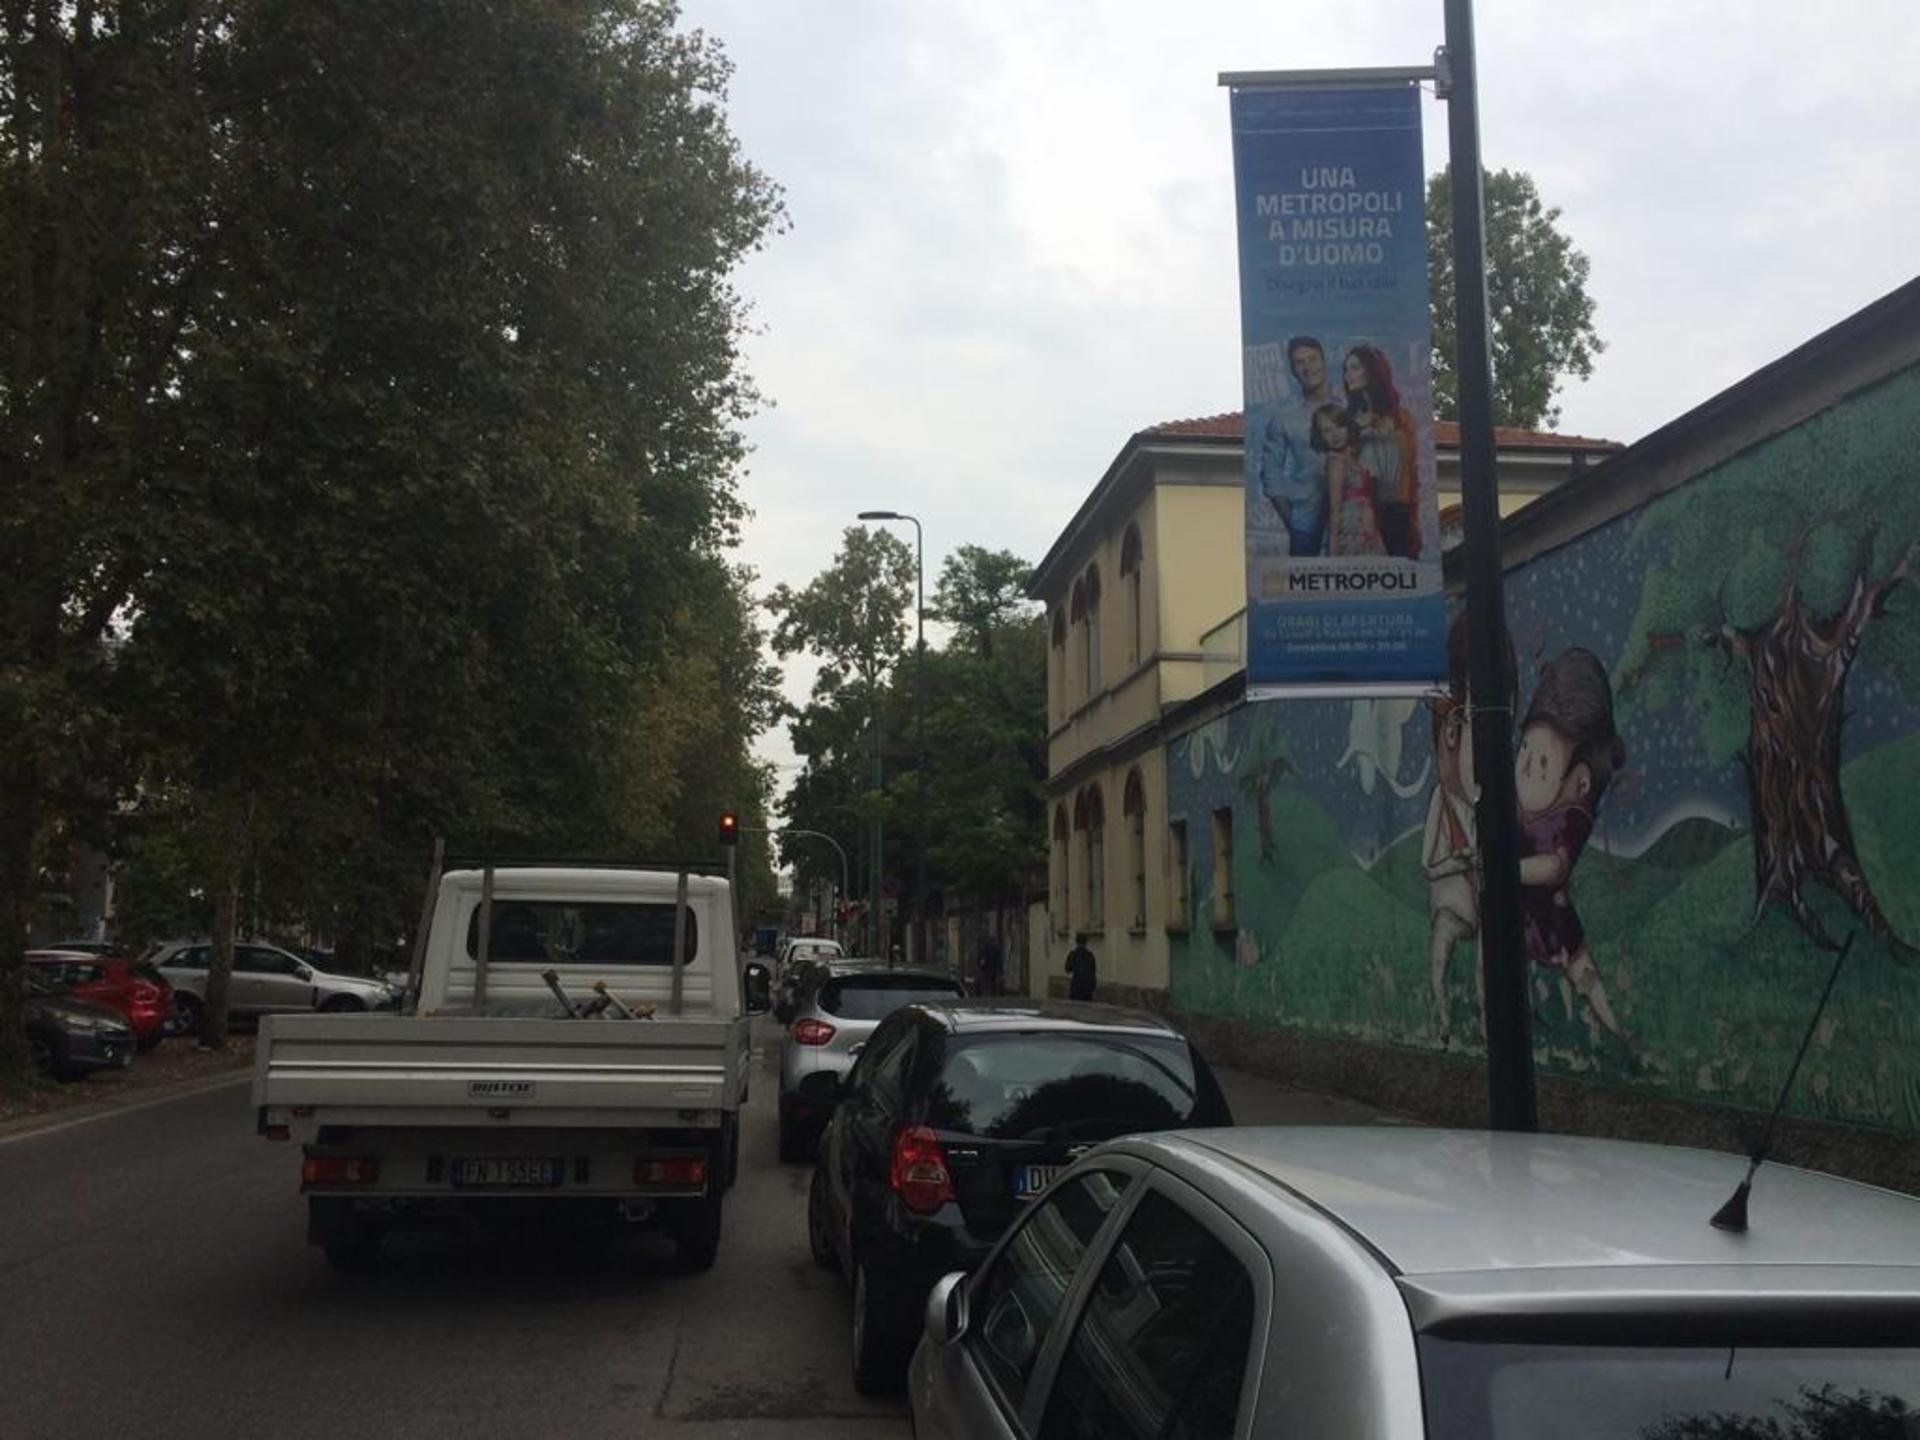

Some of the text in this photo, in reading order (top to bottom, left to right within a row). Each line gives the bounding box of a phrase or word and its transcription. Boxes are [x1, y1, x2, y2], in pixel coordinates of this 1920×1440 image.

[1301, 166, 1357, 190] UNA
[1256, 191, 1402, 217] METROPOLI
[1267, 216, 1393, 241] A MISURA
[1278, 242, 1384, 266] D'UOMO
[1289, 572, 1417, 591] METROPOLI
